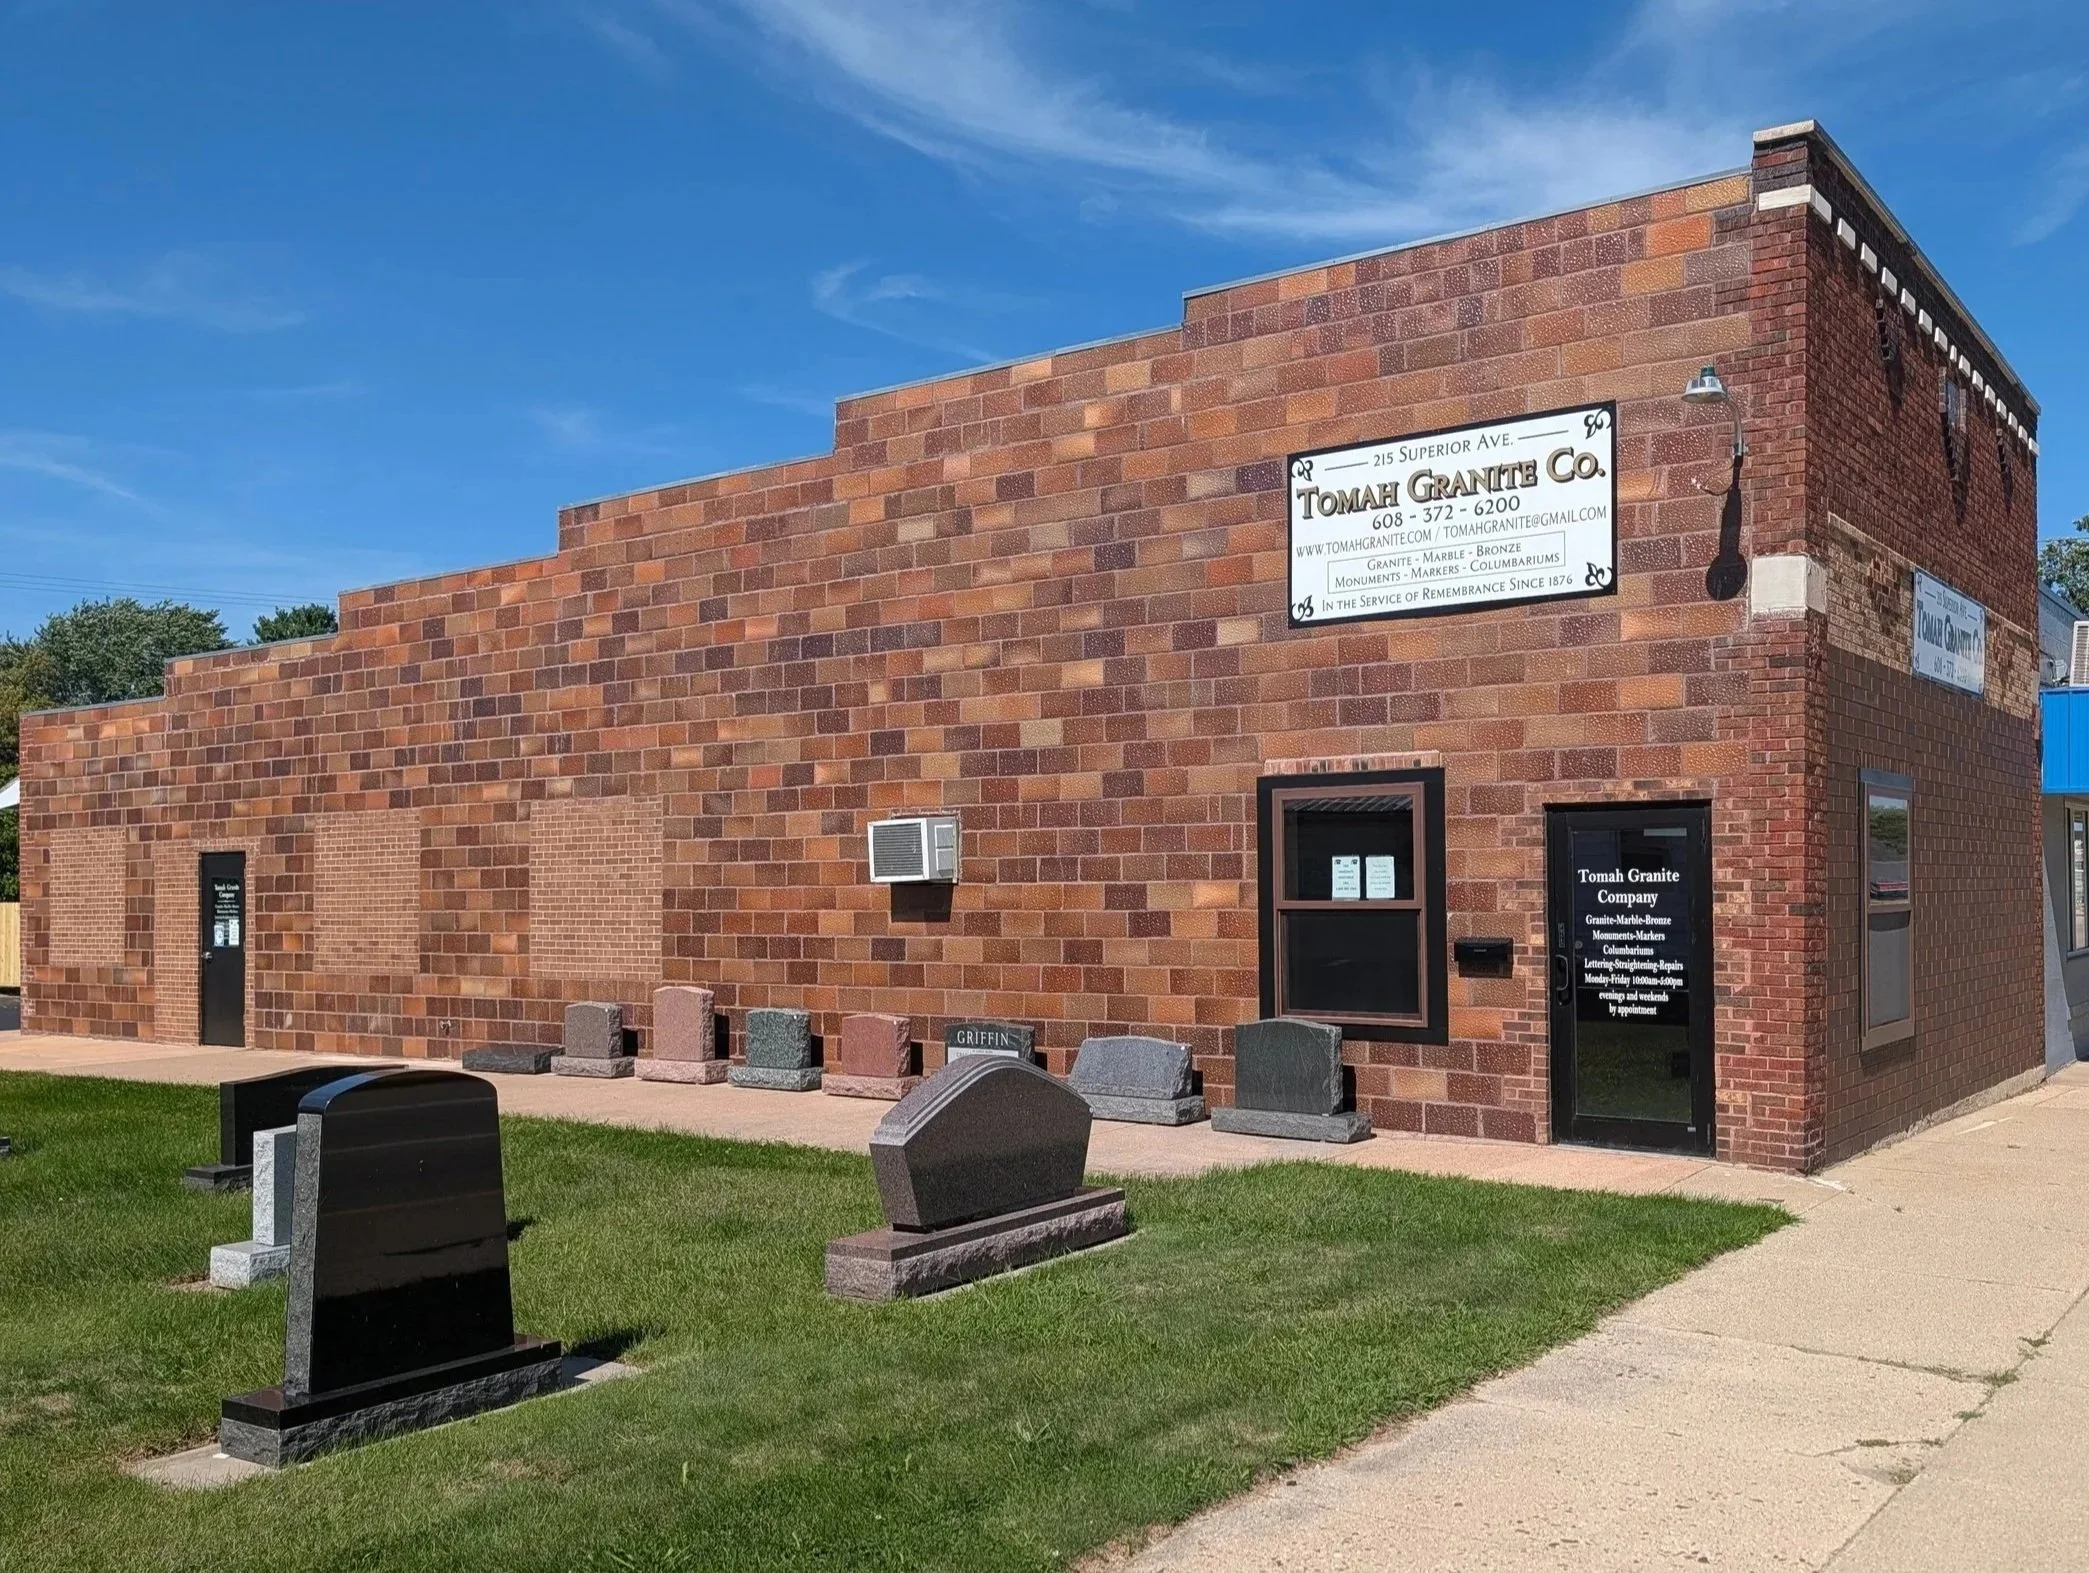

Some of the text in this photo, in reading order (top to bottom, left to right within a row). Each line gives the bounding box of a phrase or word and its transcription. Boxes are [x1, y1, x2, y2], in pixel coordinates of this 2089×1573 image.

[1374, 433, 1514, 467] 215 SUPERIOR AVE.
[1296, 446, 1606, 520] TOMAH GRANITE CO.
[1372, 511, 1403, 530] 608
[1423, 504, 1453, 523] 372
[1474, 495, 1520, 517] 6200
[1296, 527, 1432, 558] WWW.TOMAHGRANITE.COM
[1443, 505, 1607, 539] TOMAHGRANITE@GMAIL.COM
[1367, 557, 1412, 571] GRANITE
[1423, 549, 1465, 564] MARBLE
[1476, 543, 1522, 557] BRONZE
[1335, 573, 1401, 589] MONUMENTS
[1411, 565, 1459, 579] MARKERS
[1470, 553, 1560, 572] COLUMBARIUMS
[1322, 574, 1573, 612] IN THE SERVICE OF REMEMBRANCE SINCE 1876
[1917, 600, 1943, 649] TOMAH
[1578, 867, 1680, 883] Tomah Granite
[1597, 889, 1658, 908] Company
[1585, 914, 1672, 925] Granite-Marble-Bronze
[1592, 929, 1666, 941] Monuments-Markers
[1603, 944, 1654, 955] Columbariums
[1584, 958, 1684, 974] Lettering-Straightening-Repairs
[1584, 973, 1631, 988] Monday-Friday
[1599, 990, 1669, 1003] evenings and weekends
[1609, 1002, 1657, 1017] by appointment
[957, 1030, 1009, 1046] GRIFFIN
